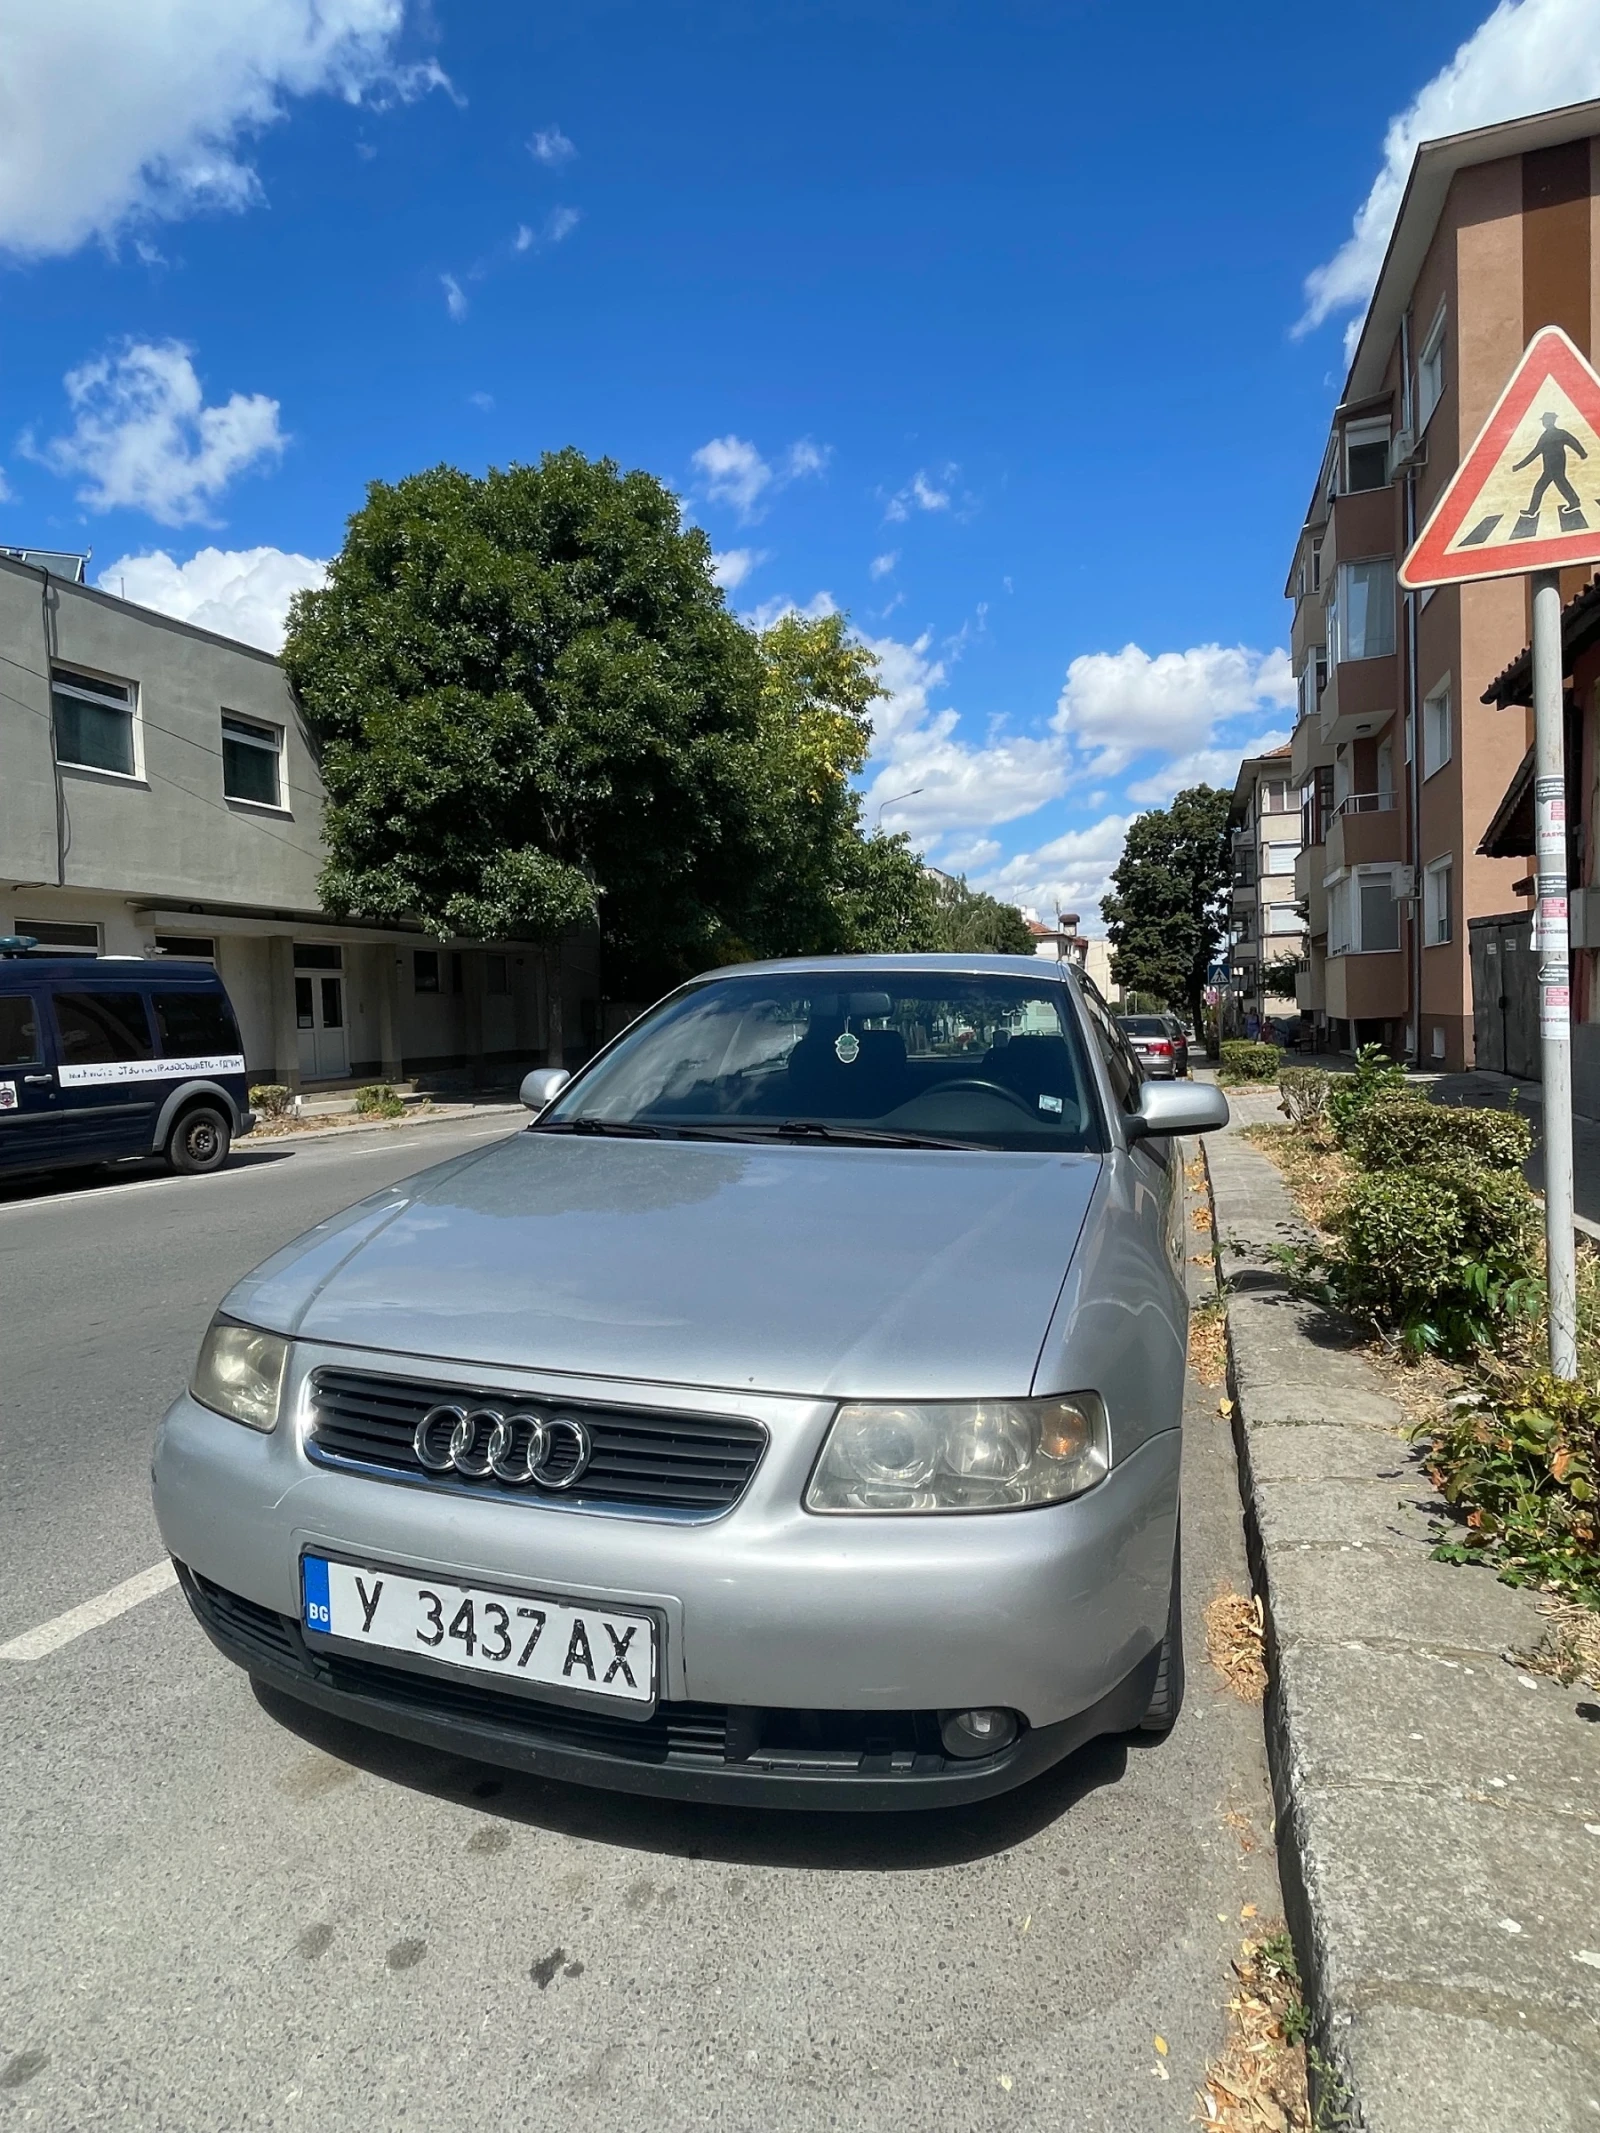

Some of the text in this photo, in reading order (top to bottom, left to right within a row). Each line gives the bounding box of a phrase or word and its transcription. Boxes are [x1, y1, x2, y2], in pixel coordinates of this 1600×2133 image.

[309, 1602, 329, 1623] BG
[416, 1590, 546, 1668] 3437
[562, 1618, 638, 1689] AX
